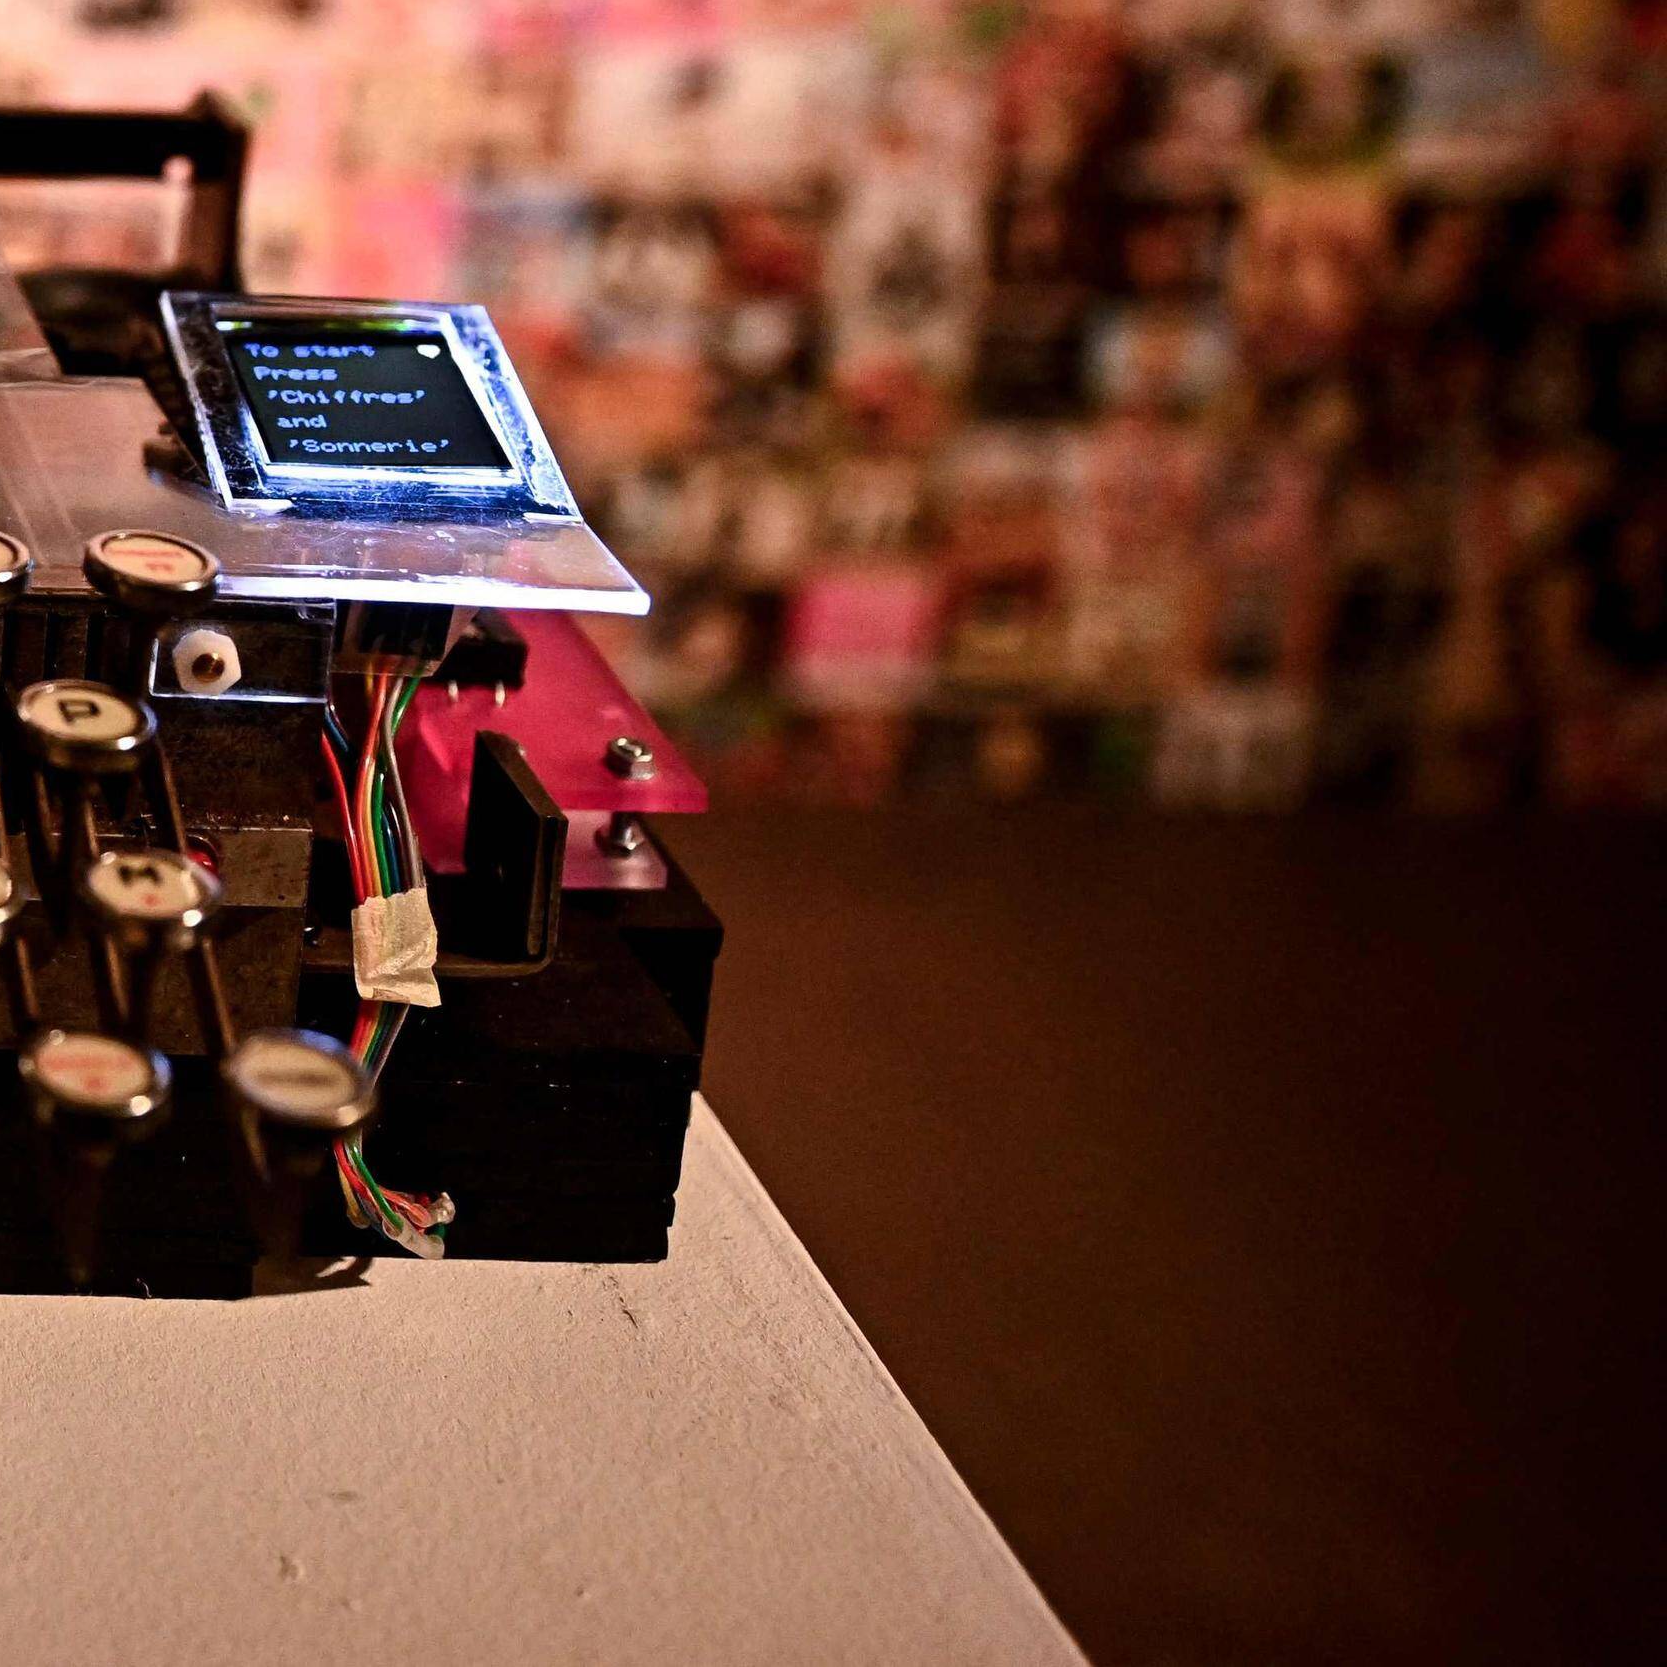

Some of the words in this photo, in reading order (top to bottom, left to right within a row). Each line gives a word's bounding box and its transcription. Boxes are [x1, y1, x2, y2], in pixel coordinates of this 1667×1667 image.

[245, 343, 278, 357] To
[294, 343, 375, 358] start
[254, 366, 337, 381] Press
[269, 389, 425, 405] 'Chiffres'
[277, 414, 327, 429] and
[289, 439, 449, 453] 'Sonnerie'
[60, 699, 99, 723] P
